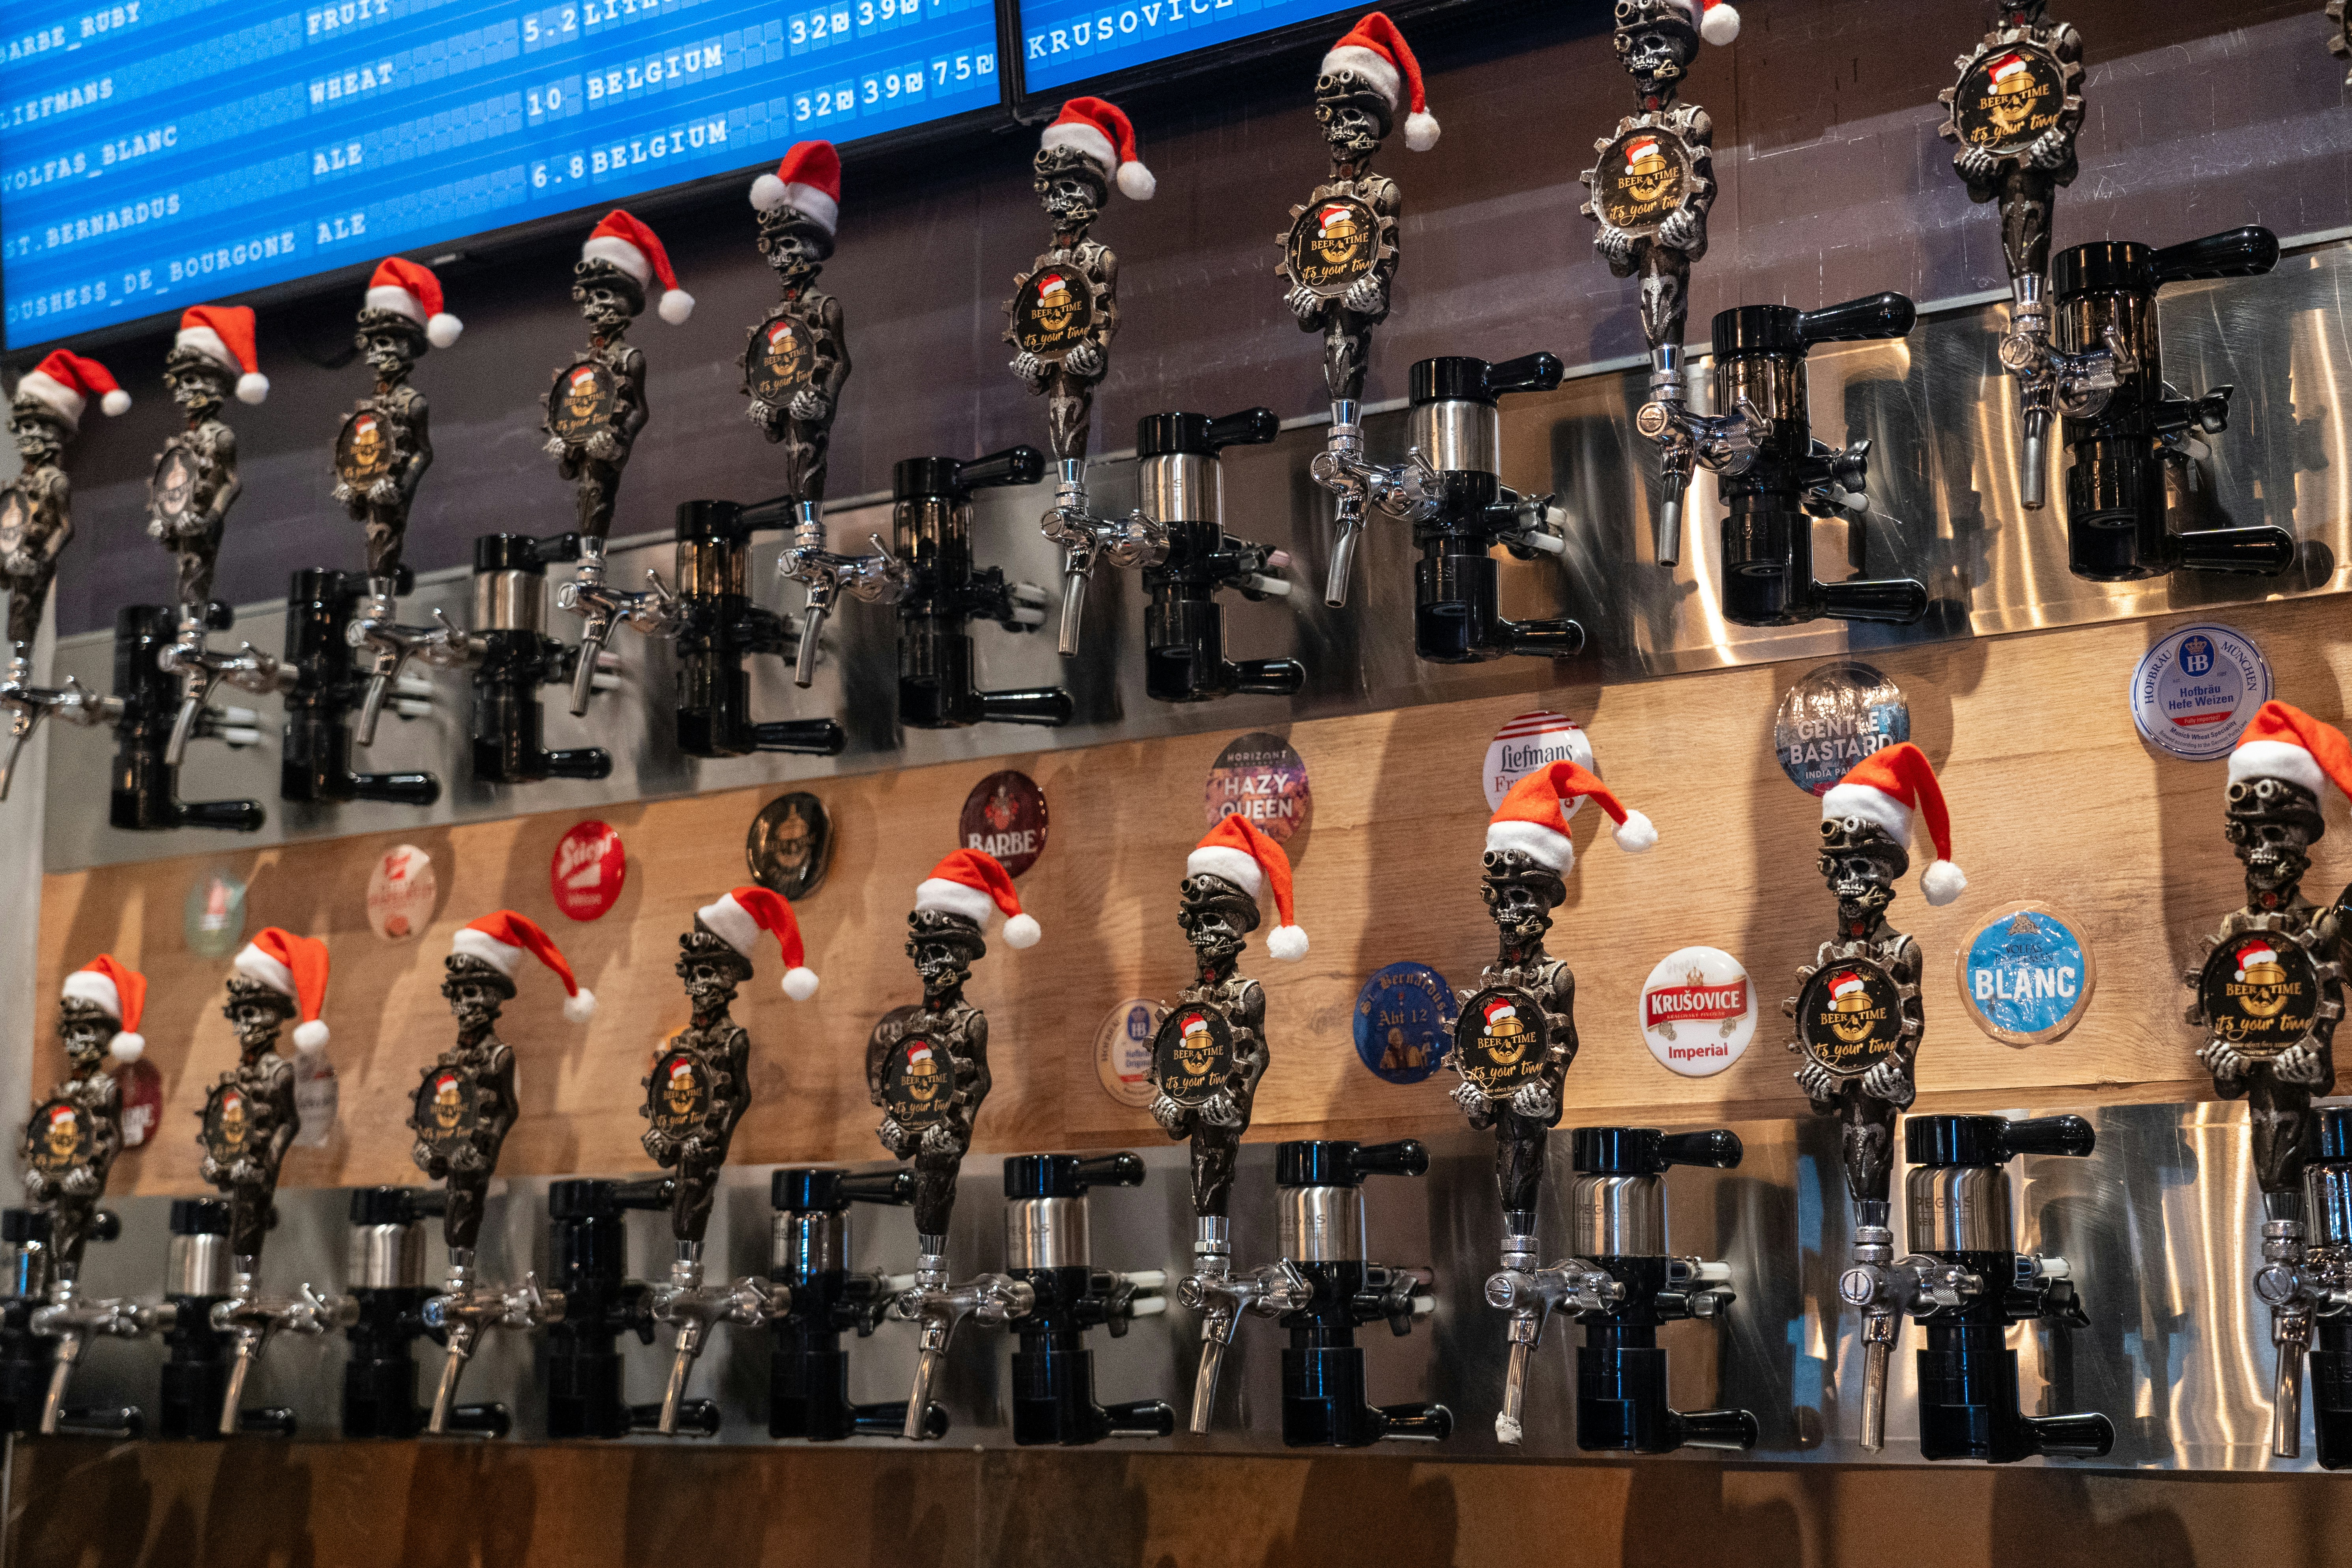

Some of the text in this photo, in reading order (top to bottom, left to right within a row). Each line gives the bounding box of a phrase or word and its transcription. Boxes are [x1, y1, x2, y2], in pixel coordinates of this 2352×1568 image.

[310, 62, 393, 104] WHEAT
[525, 9, 576, 41] 5.2
[1980, 83, 2050, 110] BEER TIME
[6, 194, 180, 259] ST.BERNARDUS
[314, 144, 361, 175] ALE
[528, 88, 561, 116] 10
[588, 44, 722, 100] BELGIUM
[318, 213, 365, 244] ALE
[533, 157, 583, 188] 6.8
[592, 120, 727, 174] BELGIUM
[1618, 167, 1679, 189] BEER TIME
[1619, 201, 1657, 226] your
[1311, 232, 1369, 251] BEER TIME
[1312, 263, 1347, 285] your
[1031, 301, 1082, 319] BEER TIME
[1032, 331, 1063, 352] your
[2144, 642, 2257, 704] HOFBRÄU MÜNCHEN
[2169, 694, 2234, 710] Hefe Weizen
[2180, 685, 2221, 698] Hofbräu
[2170, 727, 2190, 739] Munich
[2210, 720, 2237, 738] Speciality
[1501, 745, 1572, 772] Liefmans
[1791, 733, 1894, 765] BASTARD
[1225, 773, 1289, 795] HAZY
[1806, 770, 1832, 779] INDIA
[1220, 798, 1293, 820] QUEEN
[968, 829, 1038, 857] BARBE
[1976, 966, 2075, 999] BLANC
[2226, 982, 2302, 996] BEER TIME
[1652, 990, 1740, 1015] KRUŠOVICE
[1821, 1008, 1886, 1025] BEER TIME
[1477, 1032, 1536, 1049] BEER TIME
[2227, 1018, 2275, 1041] your
[1173, 1045, 1224, 1060] BEER TIME
[1669, 1042, 1728, 1061] Imperial
[1823, 1043, 1864, 1065] your
[1173, 1076, 1205, 1096] your
[1480, 1065, 1516, 1087] your
